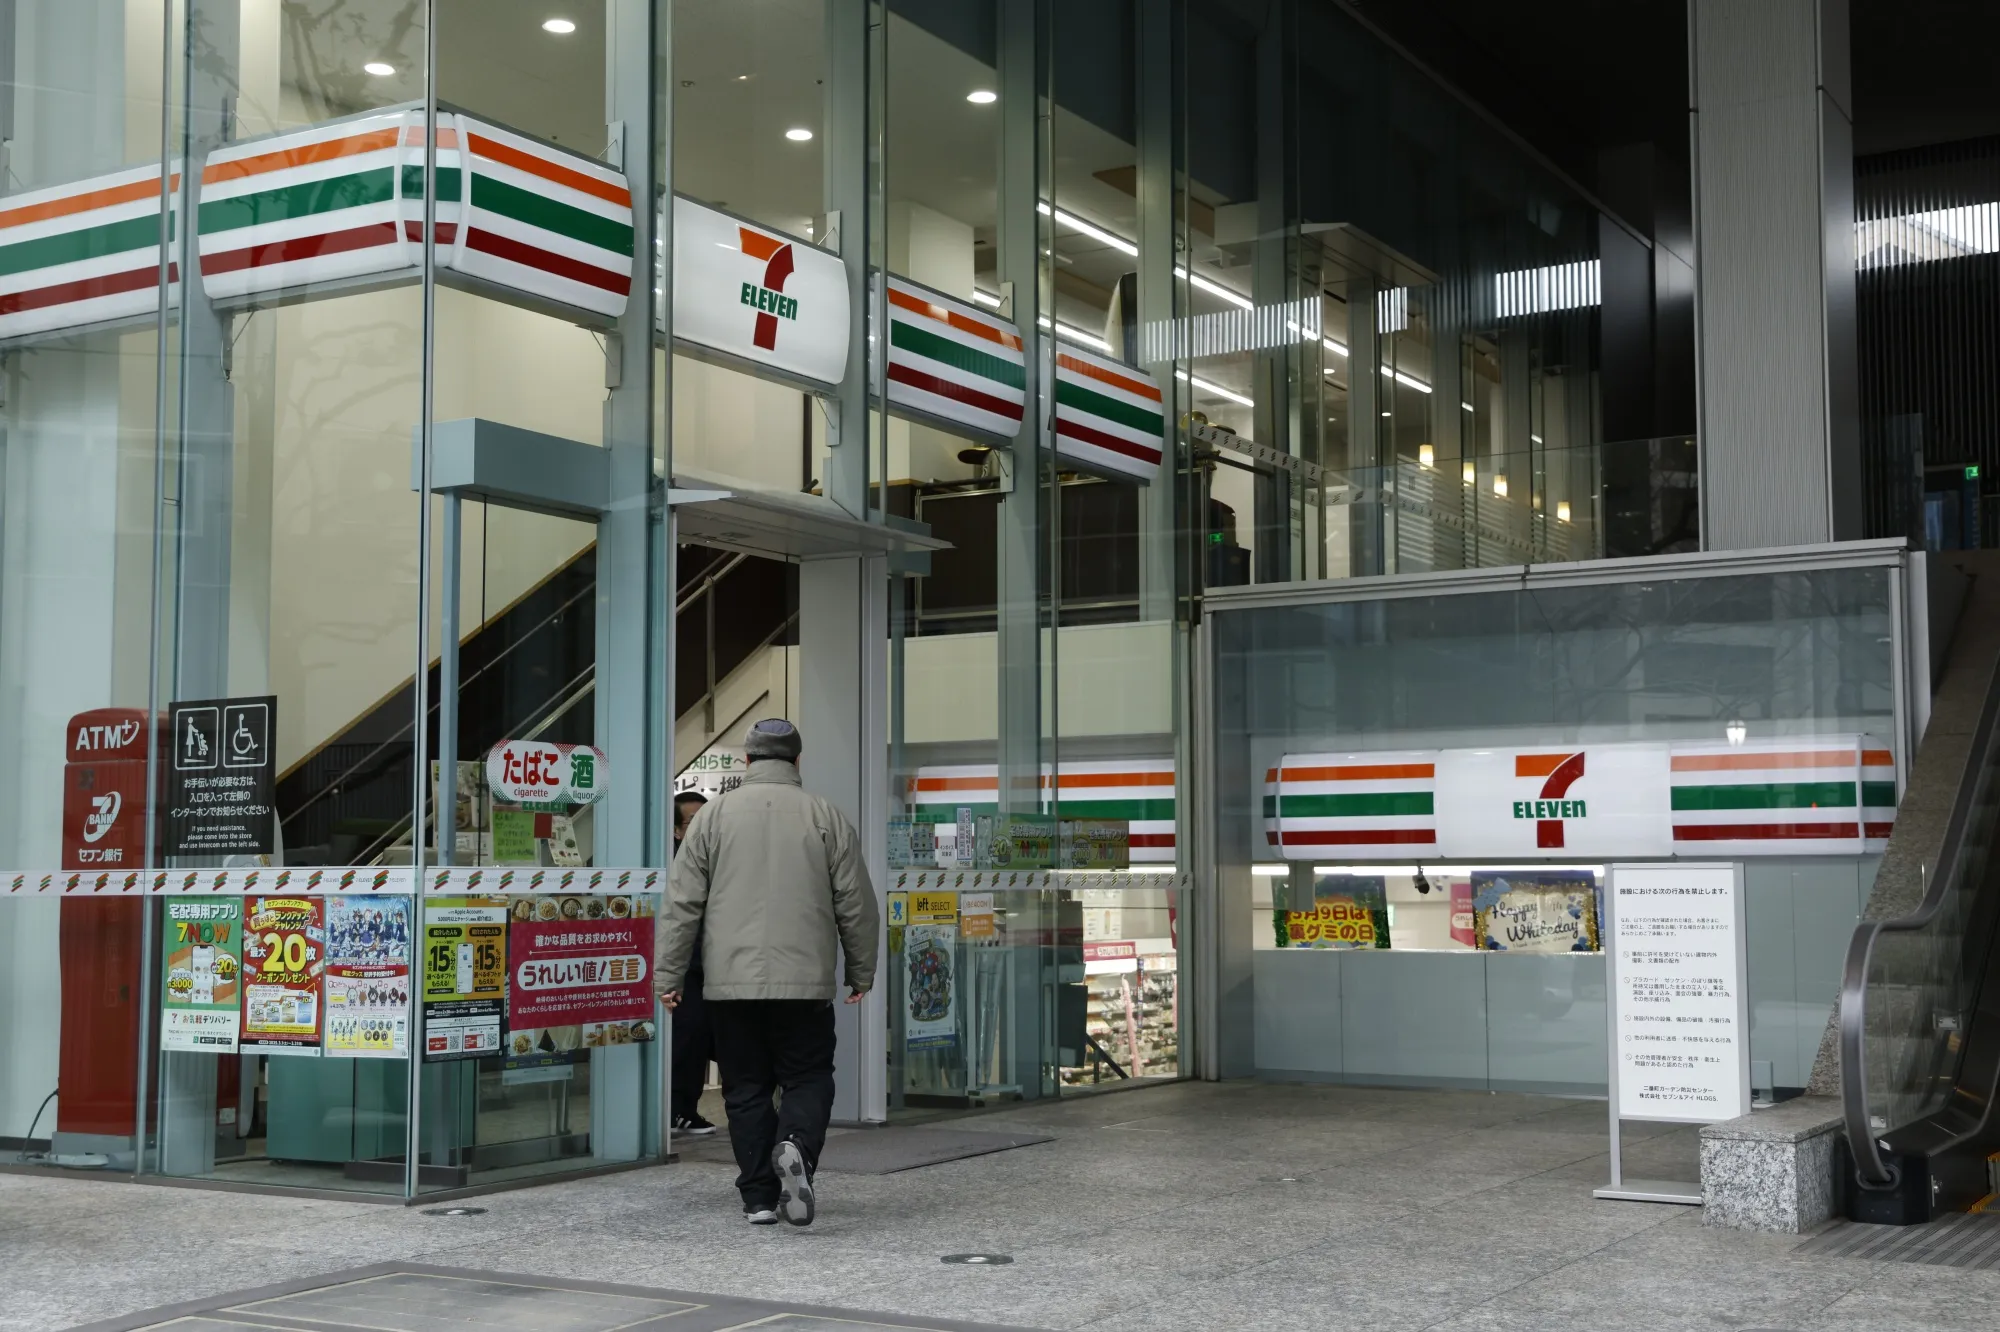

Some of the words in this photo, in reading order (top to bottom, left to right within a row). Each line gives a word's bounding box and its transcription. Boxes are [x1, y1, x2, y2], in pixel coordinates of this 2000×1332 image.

[502, 748, 560, 786] たばこ
[570, 753, 594, 789] 酒
[184, 776, 257, 788] お手伝いが必要な方は、
[189, 791, 251, 803] 入口を入って左側の
[513, 787, 549, 798] cigarette
[572, 790, 595, 801] liquor
[170, 805, 270, 818] インターホンでお知らせください
[89, 813, 114, 825] BANK
[187, 833, 204, 842] please
[238, 840, 248, 848] left
[78, 848, 123, 862] セブン銀行
[169, 904, 239, 919] 宅配専用アプリ
[931, 901, 950, 911] SELECT
[275, 910, 309, 921] ランクアップ
[1492, 902, 1538, 923] Happy
[274, 921, 302, 931] チャレンジ
[176, 922, 231, 943] 7NOW
[535, 931, 632, 947] 確かな品質をお求めやすく!
[430, 945, 451, 972] 15
[476, 944, 496, 971] 15
[256, 973, 311, 983] クーポンプレゼント
[523, 957, 640, 987] うれしい値!宣言
[182, 1015, 232, 1024] お気軽デリバリー
[1643, 1085, 1714, 1093] 二番町ガーデン防災センター
